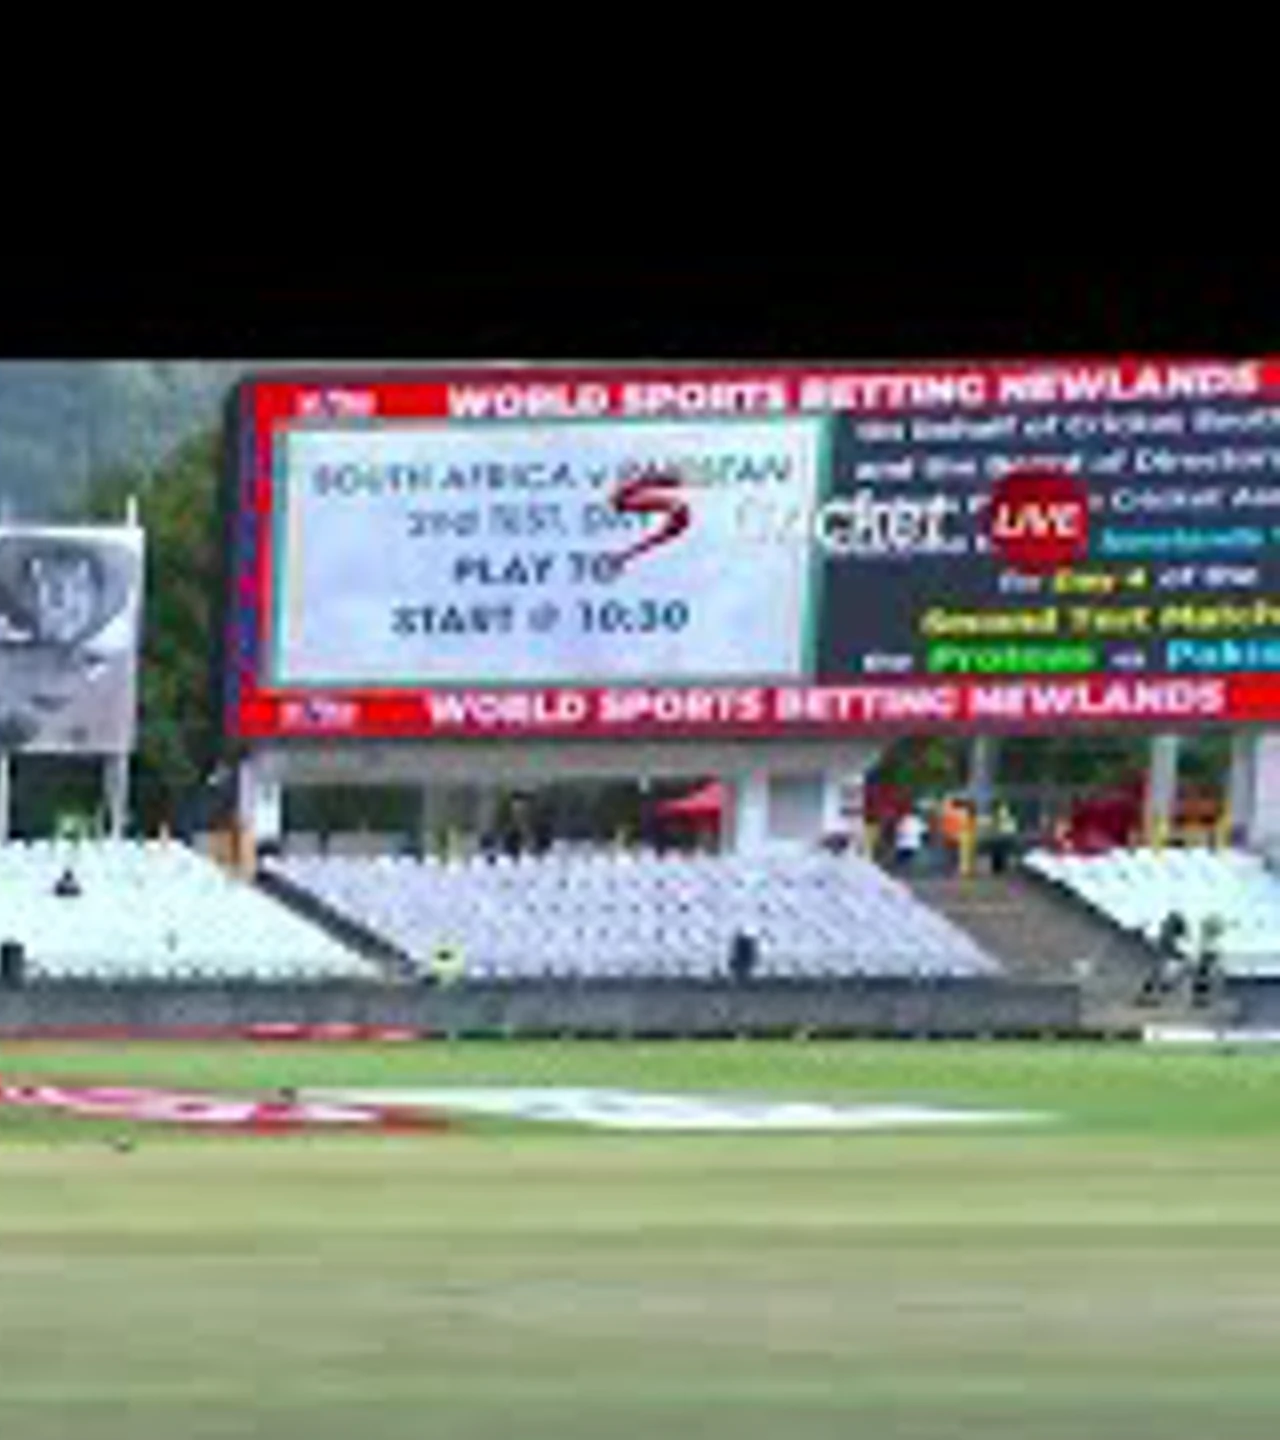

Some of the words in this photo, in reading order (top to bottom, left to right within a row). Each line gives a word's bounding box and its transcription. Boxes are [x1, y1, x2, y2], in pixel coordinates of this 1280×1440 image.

[447, 382, 607, 417] WORLD
[622, 378, 786, 414] SPORTS
[800, 373, 986, 411] BETTING
[999, 364, 1258, 403] NEWLANDS
[312, 463, 432, 496] SOUTH
[441, 460, 578, 490] AFRICA
[453, 555, 554, 585] PLAY
[391, 606, 513, 634] START
[580, 600, 688, 633] 10:30
[429, 692, 588, 725] WORLD
[598, 690, 763, 722] SPORTS
[775, 687, 953, 720] BETTING
[972, 681, 1227, 716] NEWLANDS
